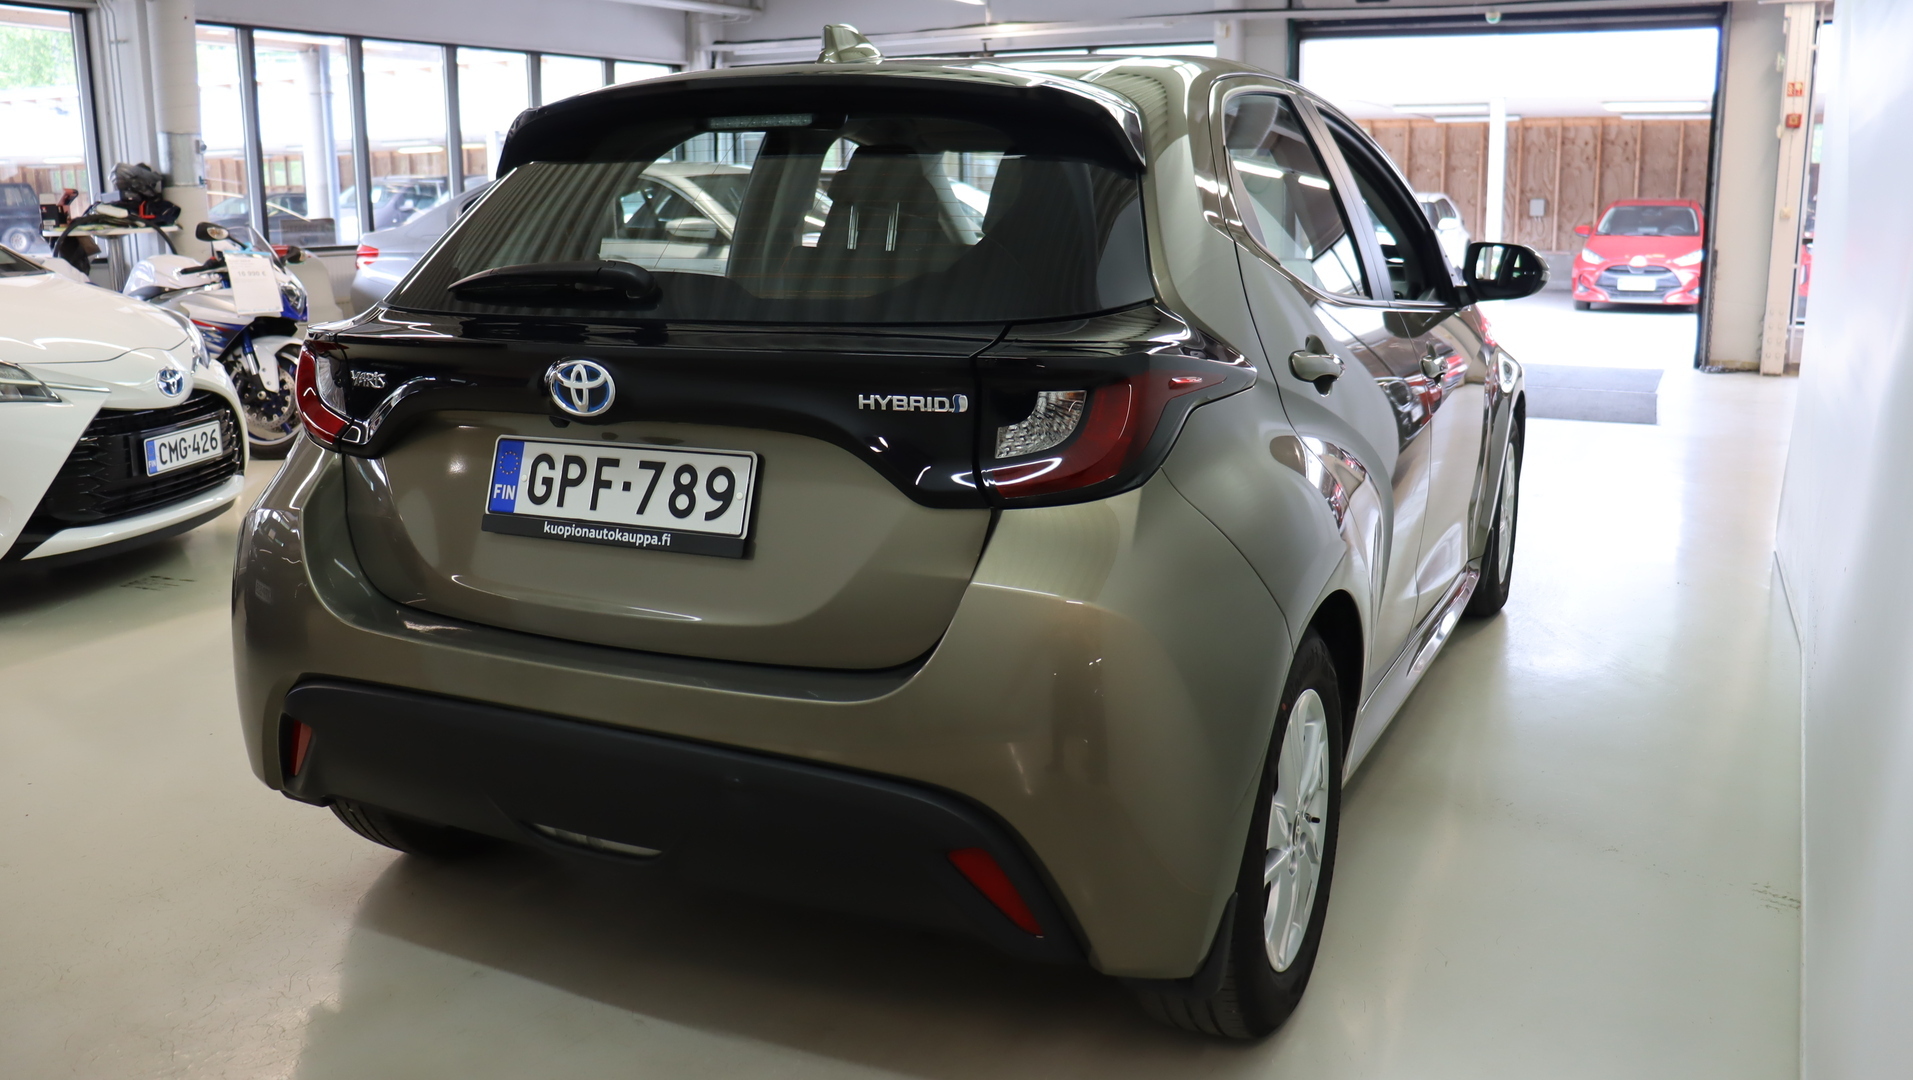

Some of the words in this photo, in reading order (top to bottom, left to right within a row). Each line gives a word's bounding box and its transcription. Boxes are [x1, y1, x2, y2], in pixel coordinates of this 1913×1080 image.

[858, 394, 950, 412] HYBRID
[149, 461, 157, 469] FIN
[493, 483, 516, 500] FIN
[527, 453, 736, 521] GPF-789
[543, 521, 671, 547] kuopionautokauppa.fi
